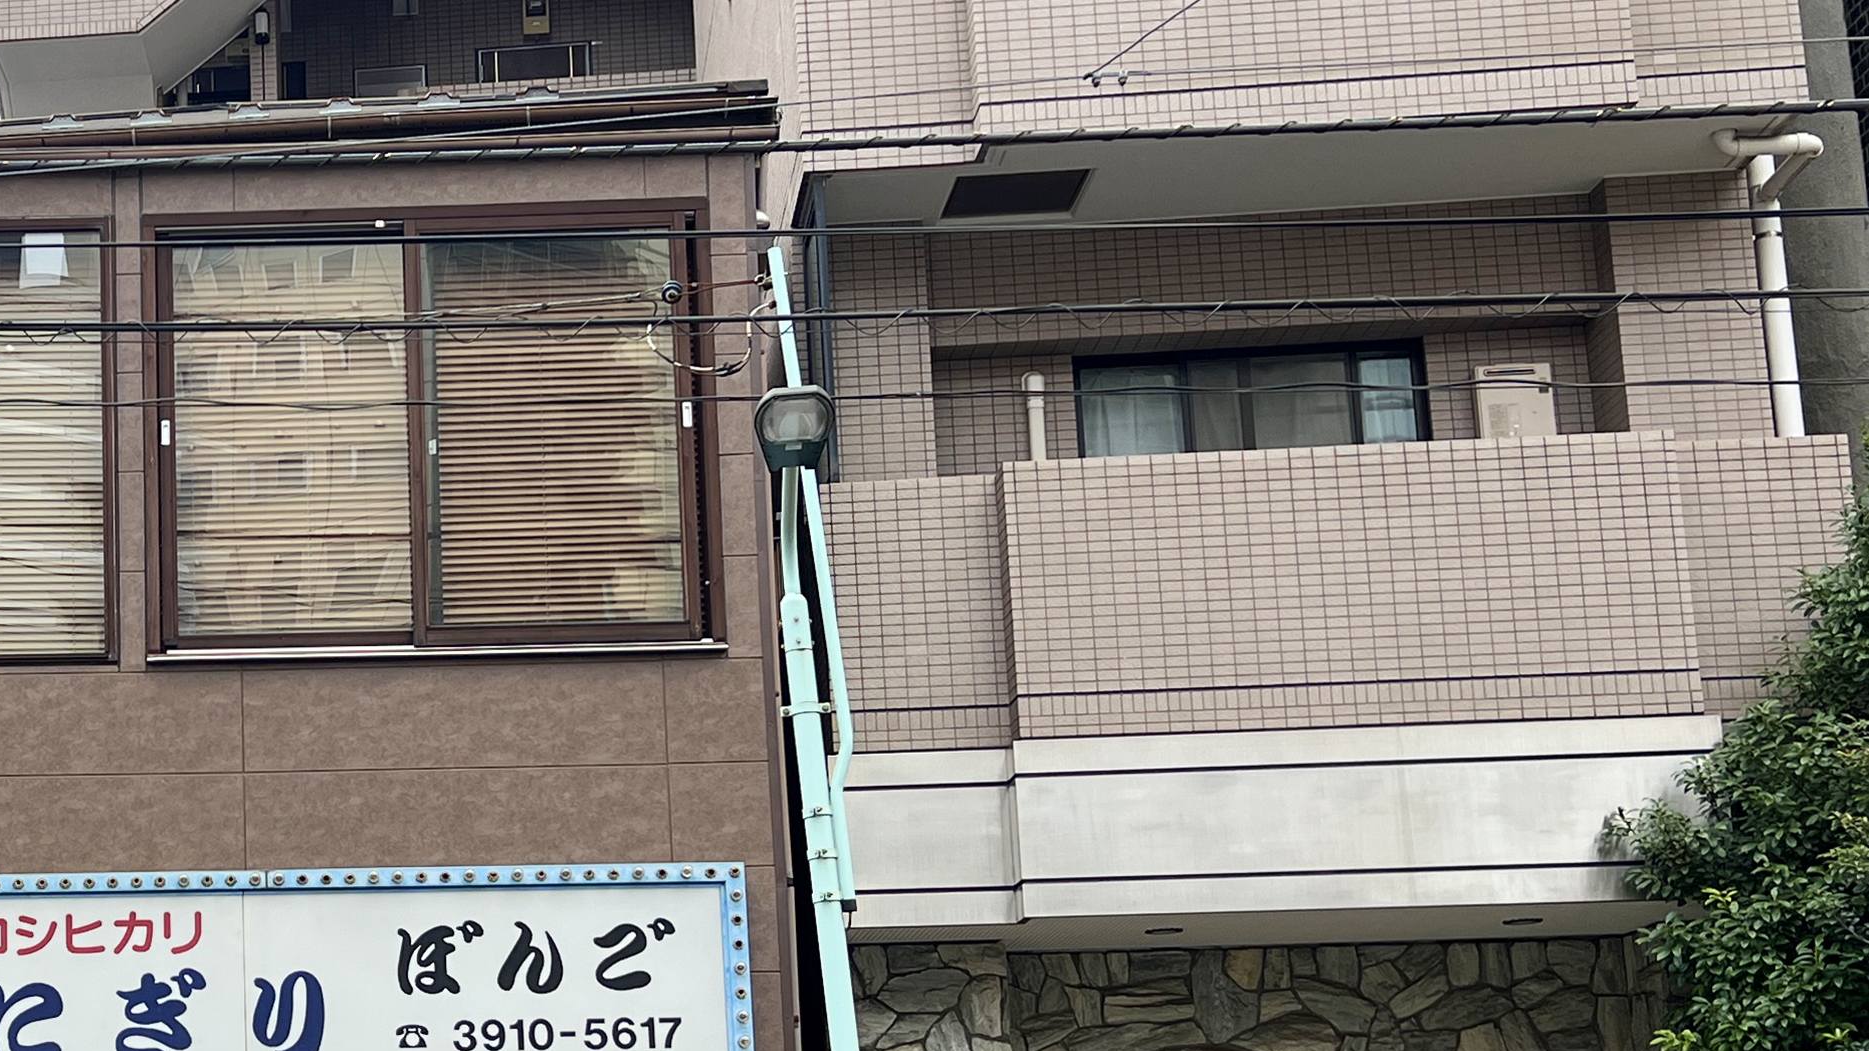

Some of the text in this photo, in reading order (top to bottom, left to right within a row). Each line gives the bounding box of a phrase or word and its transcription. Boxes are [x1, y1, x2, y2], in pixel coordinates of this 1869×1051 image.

[397, 918, 676, 995] ぼんご
[452, 1016, 683, 1051] 3910-5617
